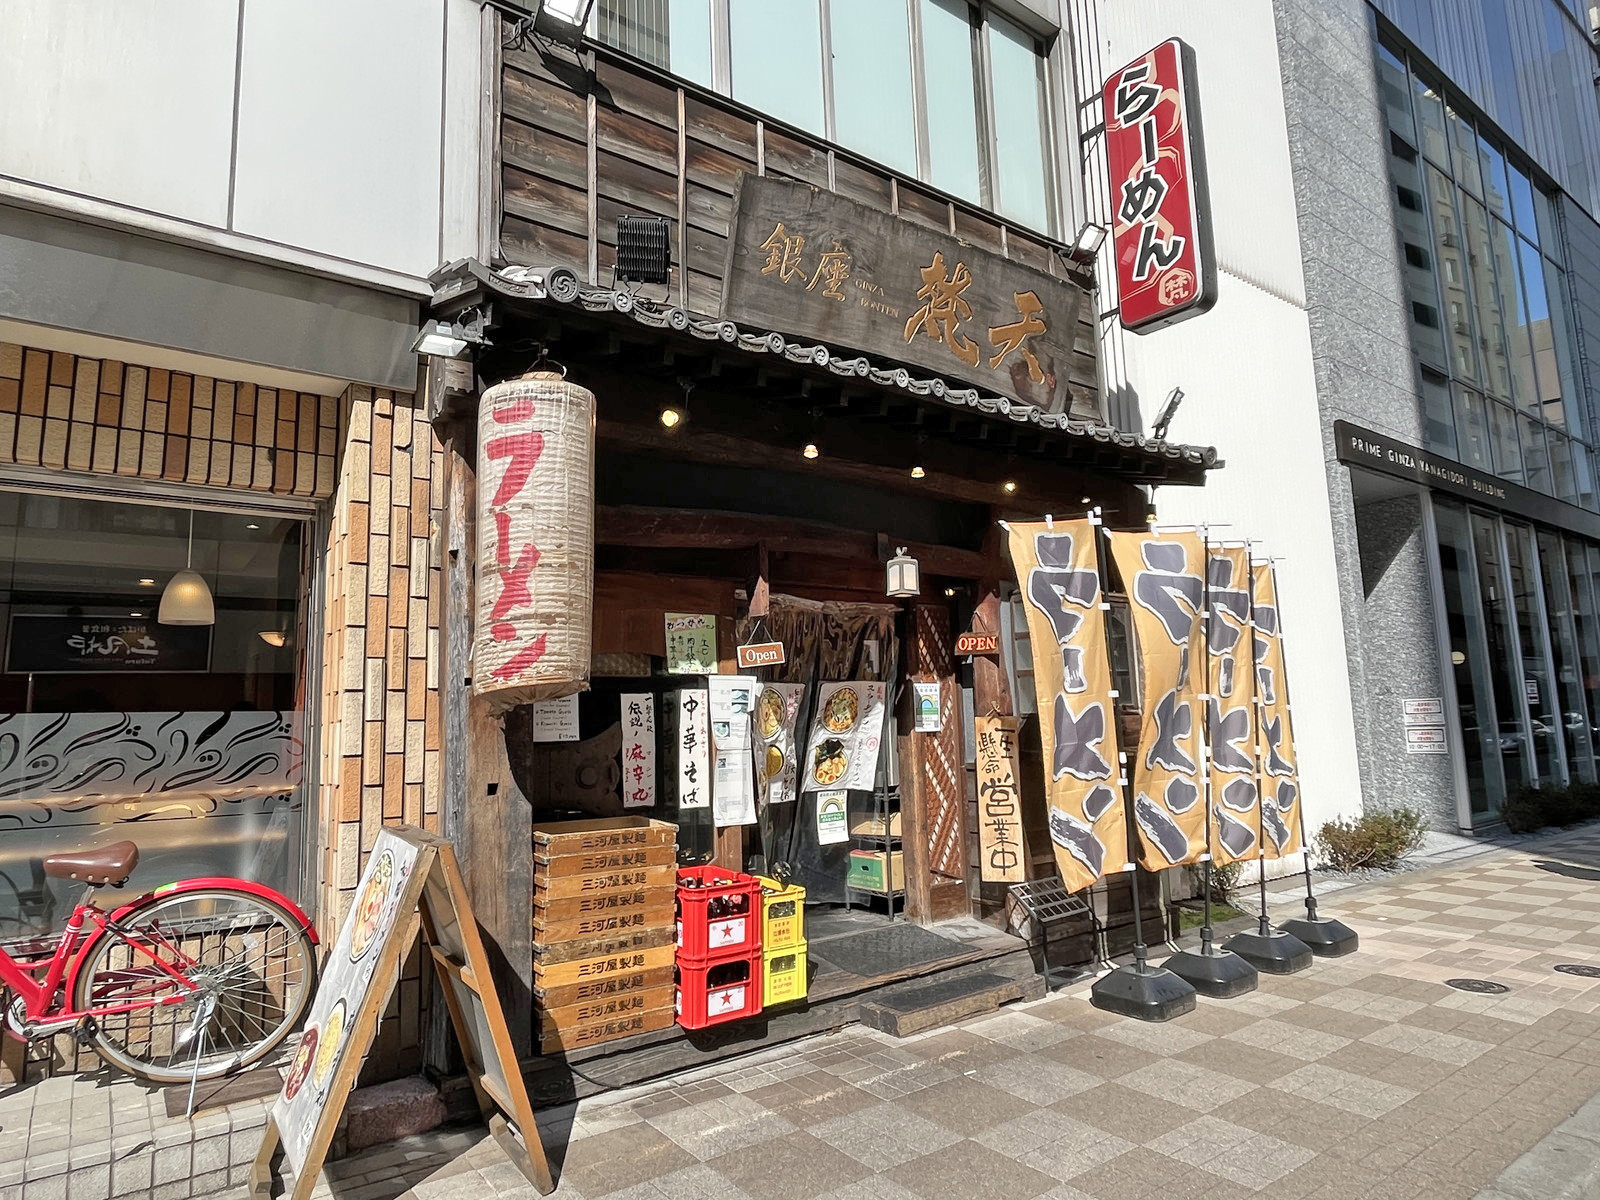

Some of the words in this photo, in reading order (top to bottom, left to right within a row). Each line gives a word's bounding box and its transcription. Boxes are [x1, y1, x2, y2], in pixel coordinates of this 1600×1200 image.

[1115, 62, 1186, 281] らーめん
[760, 221, 851, 303] 銀座
[855, 278, 884, 297] GINZA
[859, 297, 899, 318] BONTEN
[1351, 436, 1382, 458] PRIME
[1388, 449, 1416, 469] GINZA
[1418, 459, 1468, 487] YANAGIDORI
[1472, 479, 1506, 500] BUILDING
[485, 397, 548, 683] ラーメン
[745, 649, 778, 663] Open
[958, 636, 997, 651] OPEN
[1027, 532, 1113, 878] ラーメン
[1133, 540, 1203, 864] ラーメン
[1200, 555, 1257, 859] ラーメン
[682, 694, 700, 805] 中華そば
[978, 732, 1001, 774] 懸命
[994, 726, 1016, 760] 一生
[980, 773, 1019, 876] 営業中
[582, 832, 647, 849] 三河屋製麺
[581, 852, 647, 871] 三河屋製麺
[581, 873, 647, 891] 三河屋製麺
[580, 893, 646, 912] 三河屋製麺
[578, 913, 645, 935] 三河屋製麺
[578, 955, 645, 977] 三河屋製麺
[577, 974, 644, 999] 三河屋製麺
[577, 996, 644, 1021] 三河屋製麺
[576, 1017, 644, 1043] 三河屋製麺
